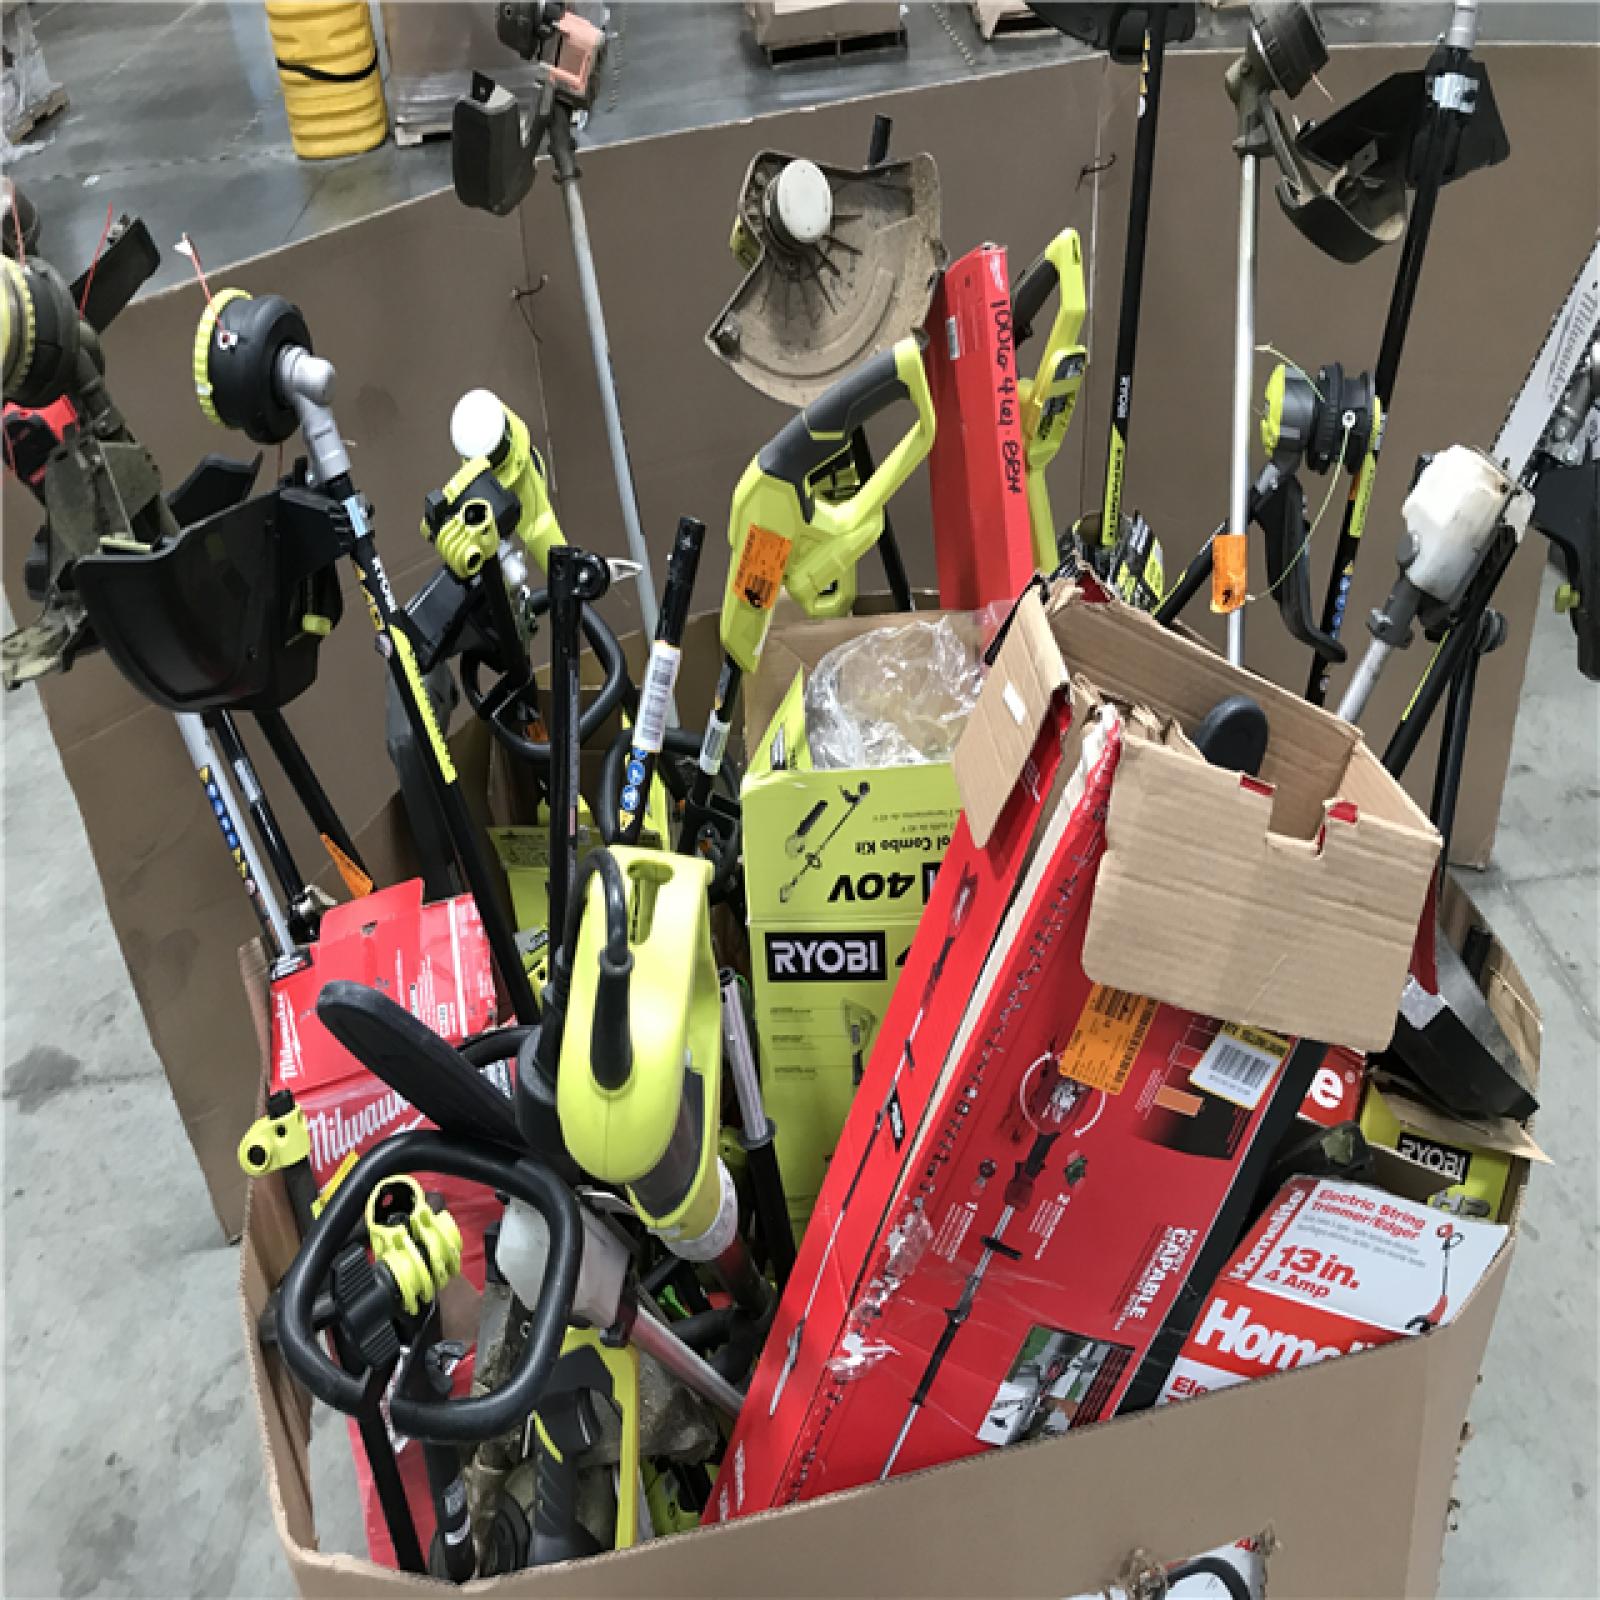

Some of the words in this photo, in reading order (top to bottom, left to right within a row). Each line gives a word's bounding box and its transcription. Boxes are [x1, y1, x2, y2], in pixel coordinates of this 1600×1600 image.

[854, 840, 876, 855] Kit
[879, 837, 931, 853] Combo
[827, 872, 916, 903] 40V
[770, 939, 880, 974] RYOBI
[1318, 1189, 1377, 1212] Electric
[1379, 1203, 1427, 1230] String
[1132, 1228, 1188, 1320] CAPABLE
[1264, 1269, 1279, 1282] 4
[1282, 1274, 1331, 1298] Amp
